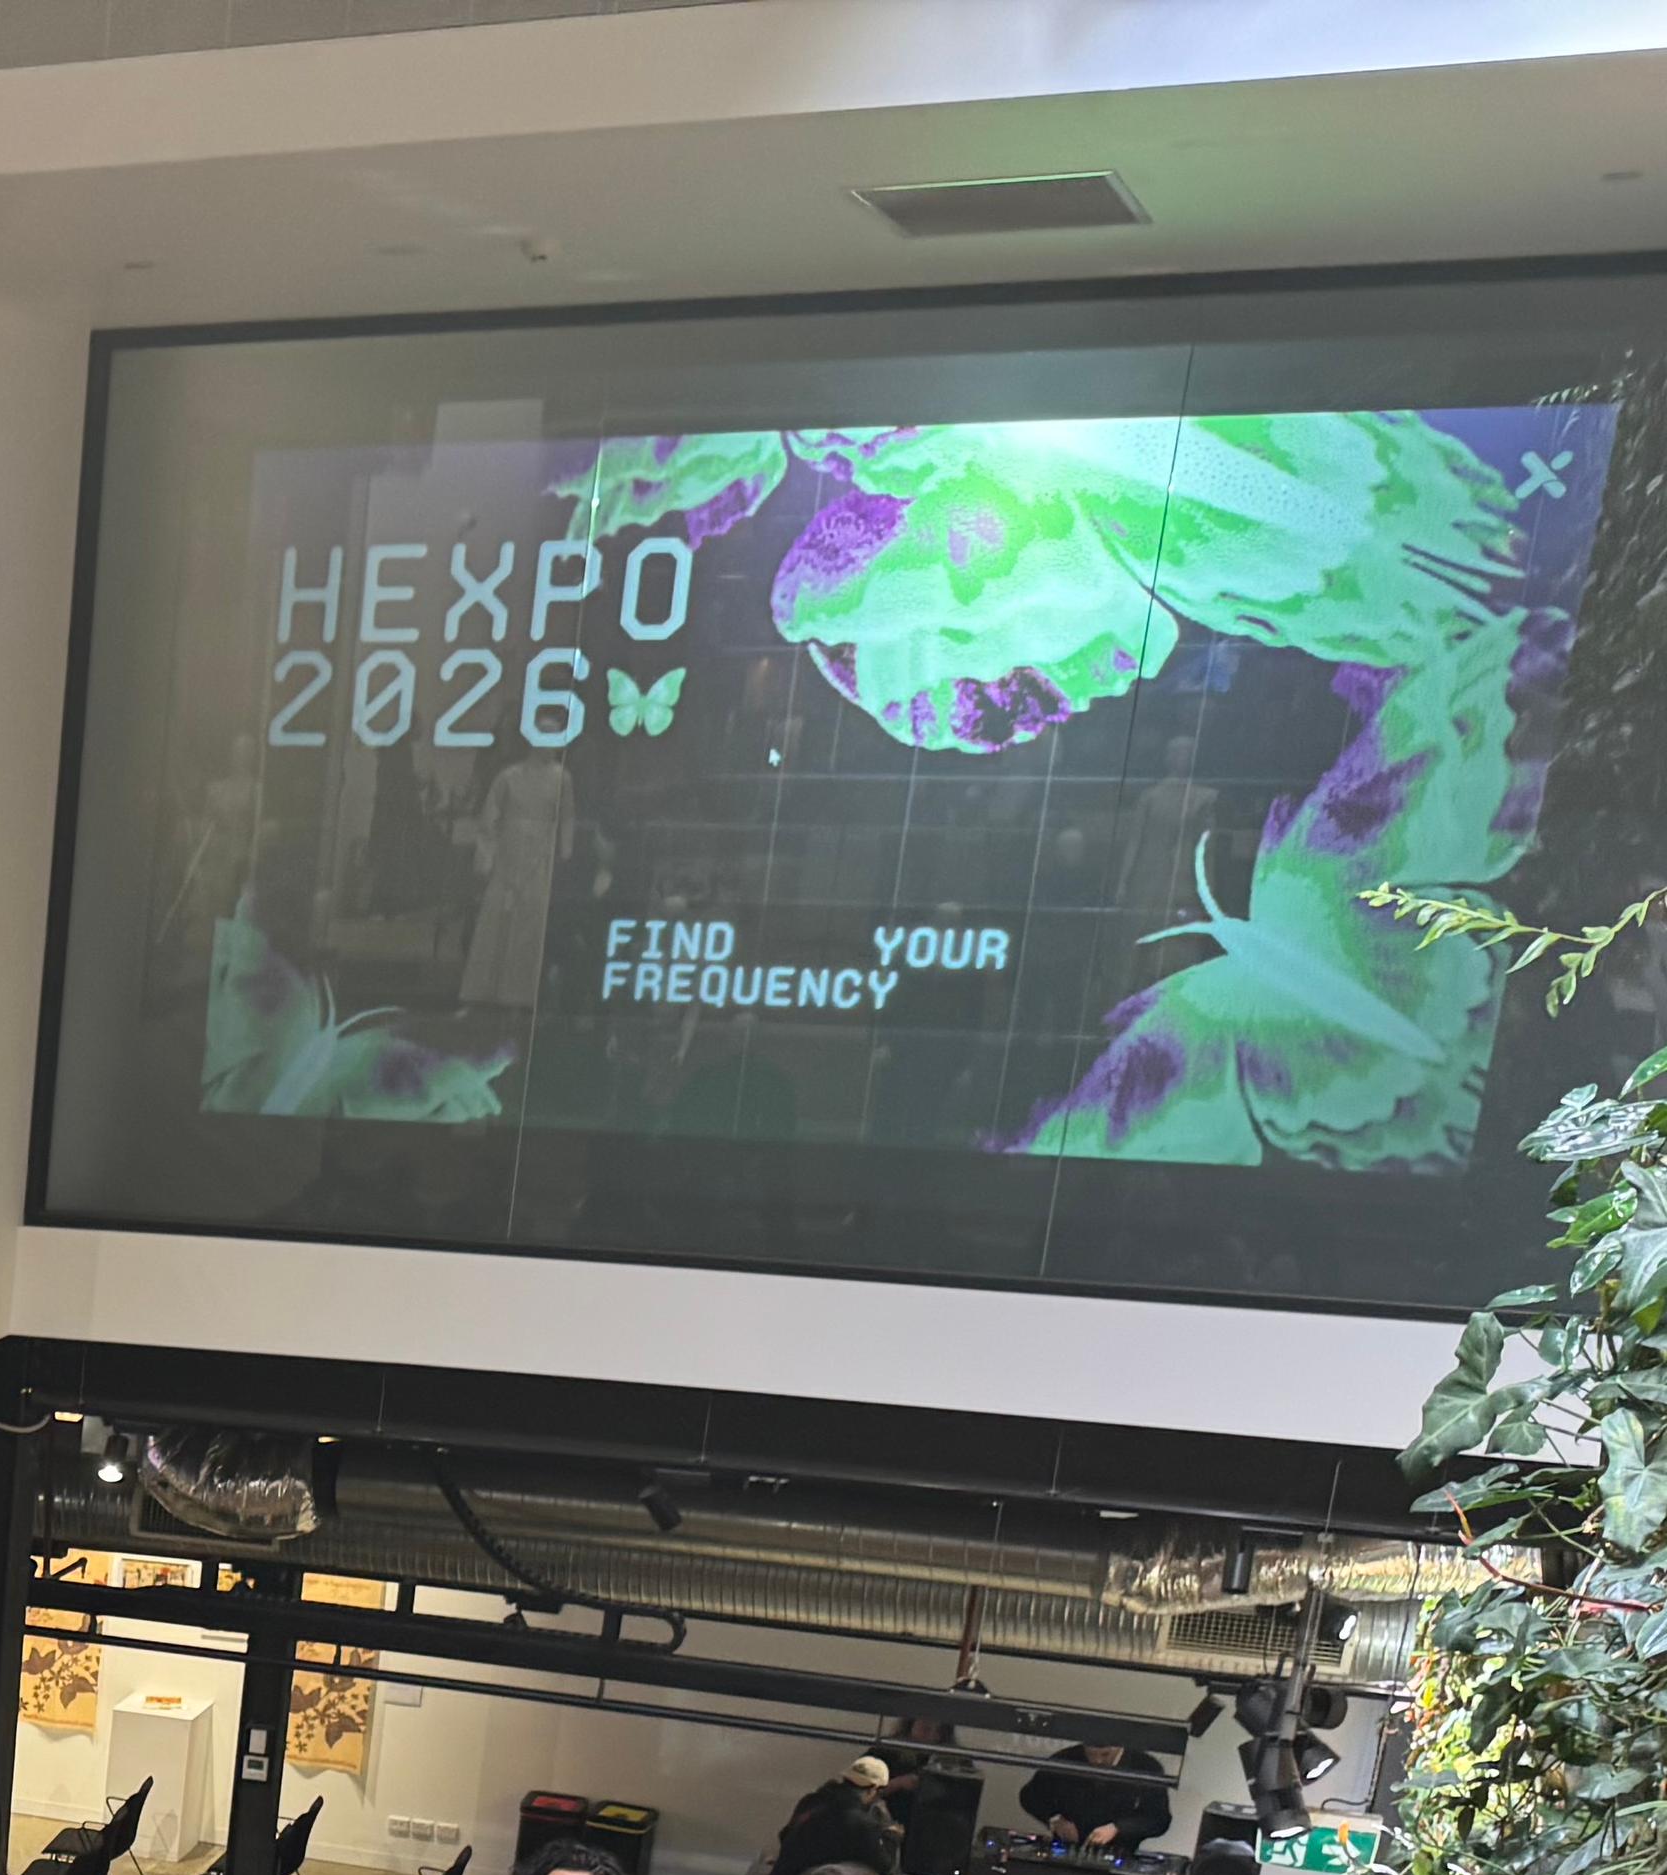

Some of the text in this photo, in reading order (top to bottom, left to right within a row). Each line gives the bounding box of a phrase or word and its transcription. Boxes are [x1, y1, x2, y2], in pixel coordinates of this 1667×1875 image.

[277, 537, 693, 643] HEXPO
[268, 648, 590, 747] 2026
[606, 919, 1010, 970] FIND YOUR
[603, 962, 899, 1010] FREQUENCY
